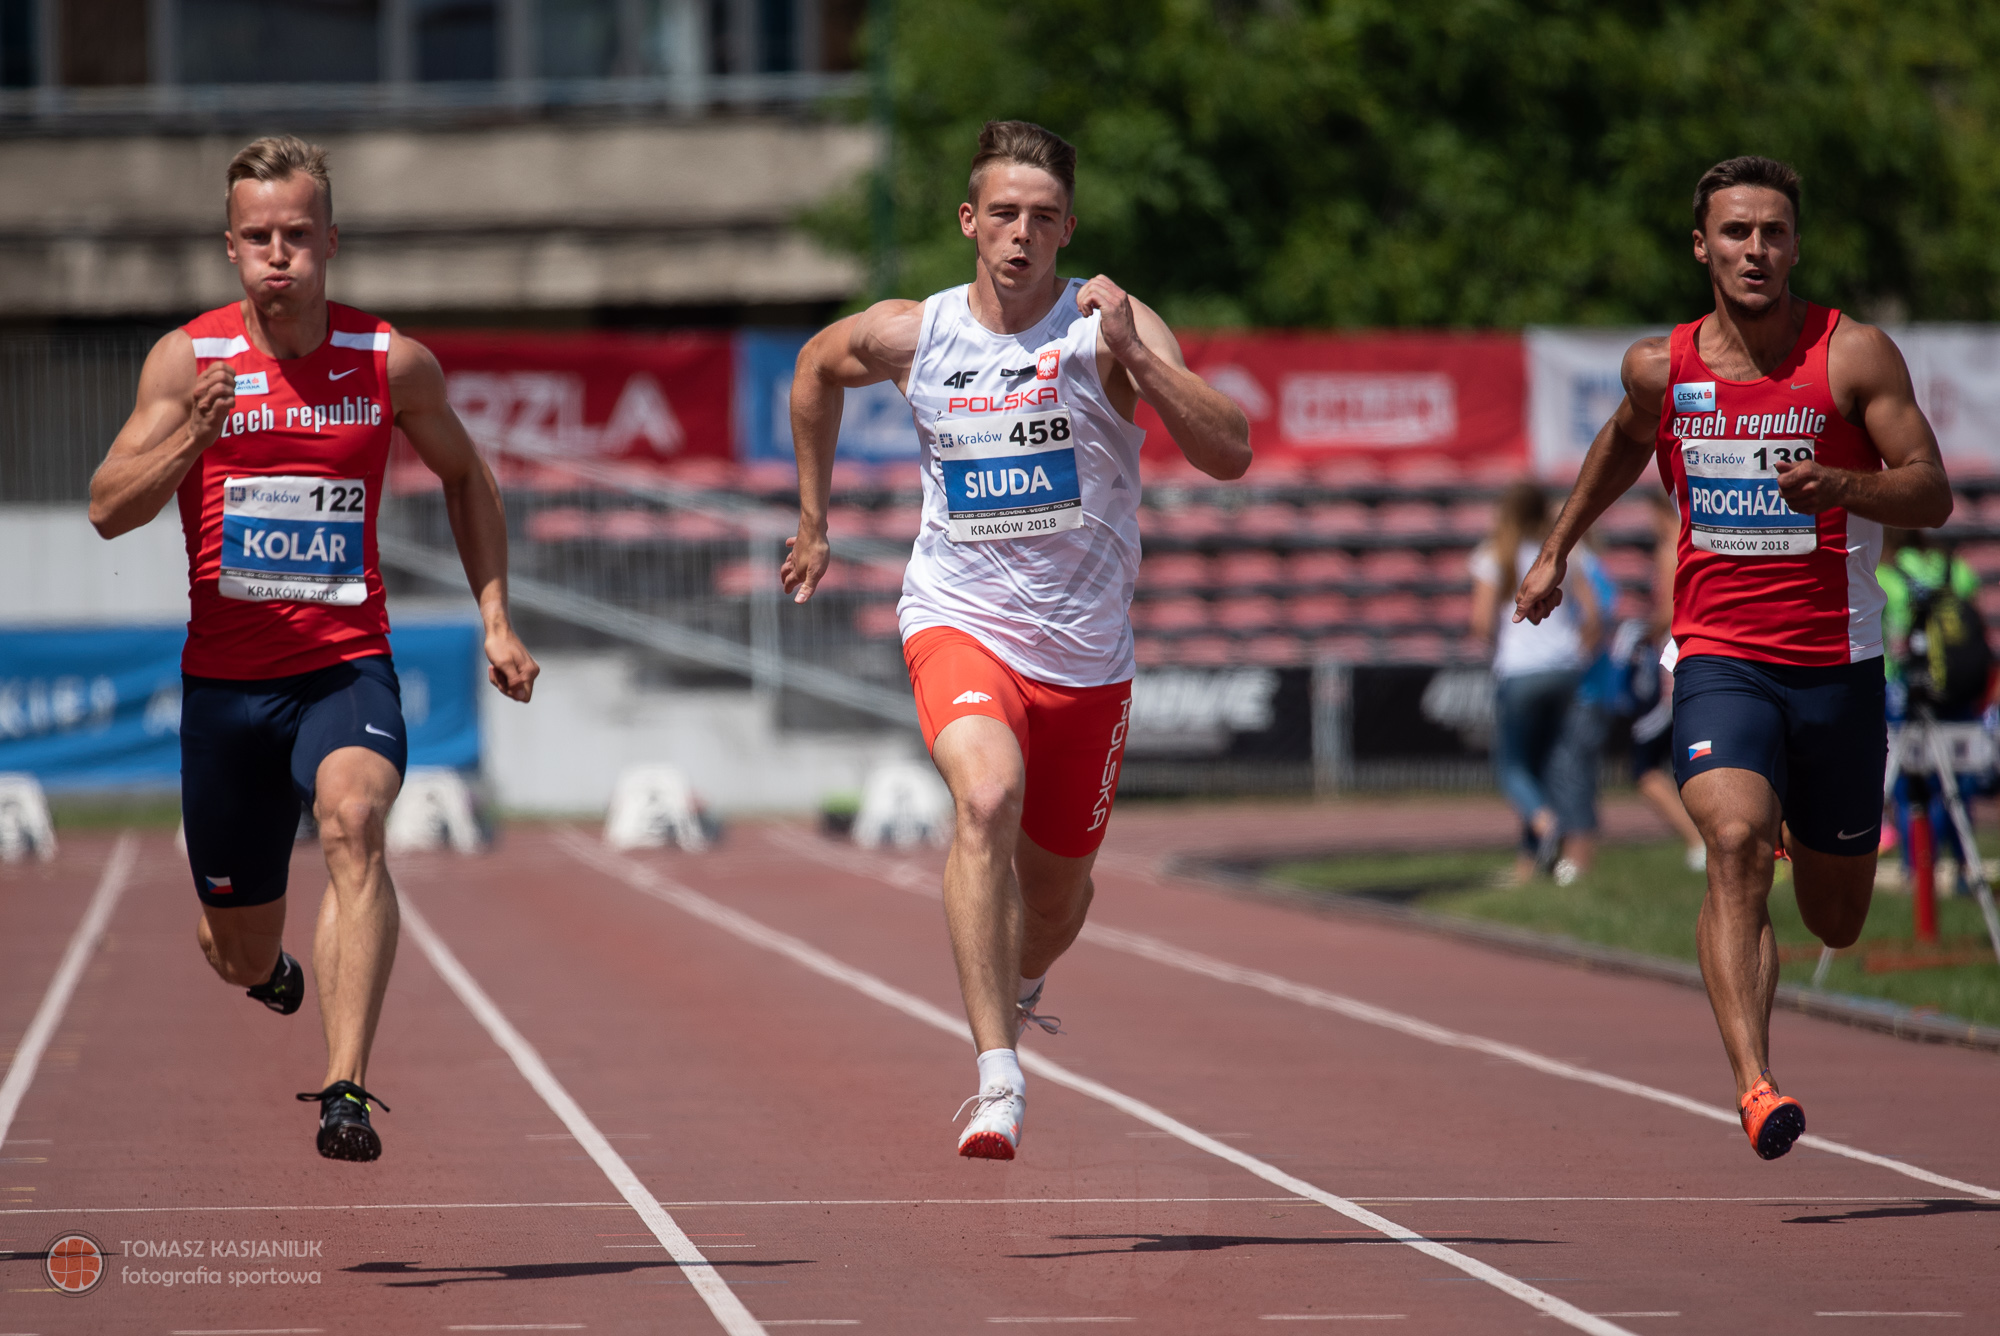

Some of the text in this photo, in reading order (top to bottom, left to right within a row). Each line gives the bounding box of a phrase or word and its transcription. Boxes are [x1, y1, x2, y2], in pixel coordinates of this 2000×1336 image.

[948, 387, 1059, 413] POLSKA
[1677, 391, 1704, 401] ČESKÁ
[220, 396, 382, 438] zech republic
[1672, 406, 1827, 440] czech republic
[957, 417, 1071, 447] Kraków 458
[1703, 452, 1746, 465] Kraków
[964, 465, 1053, 499] SIUDA
[251, 486, 365, 513] Kraków 122
[970, 517, 1057, 536] KRAKÓW 2018
[242, 527, 347, 563] KOLÁR
[1710, 538, 1790, 551] KRAKÓW 2018
[247, 584, 339, 601] KRAKÓW 2018
[1086, 696, 1132, 832] POLSKA
